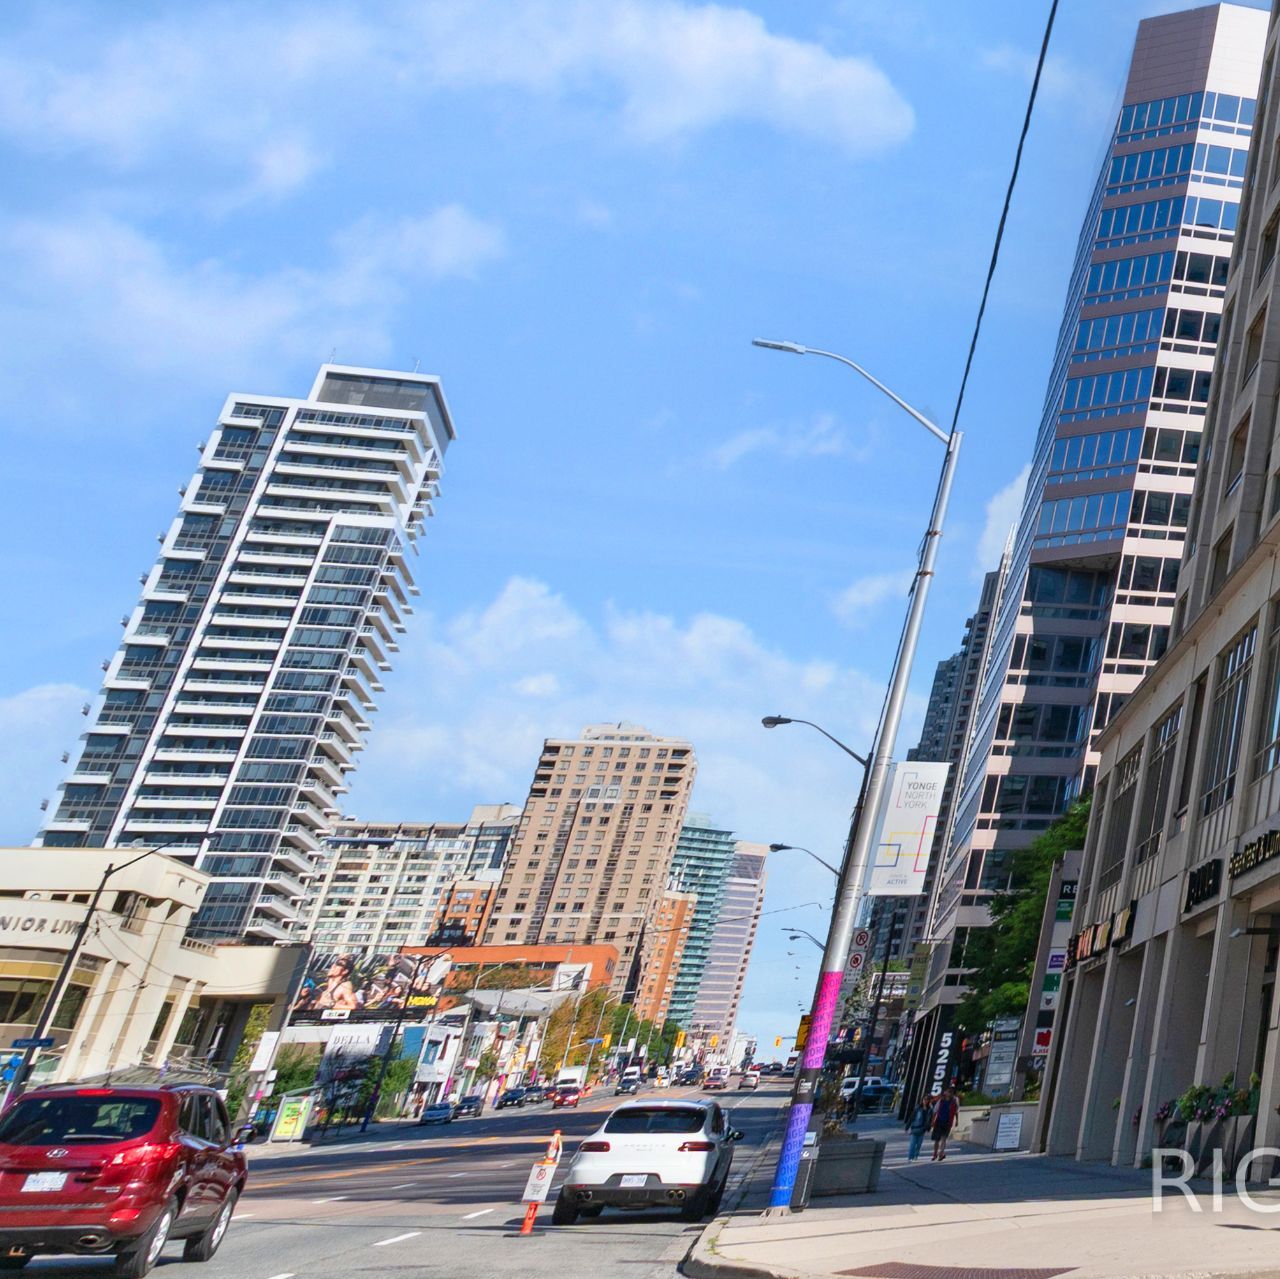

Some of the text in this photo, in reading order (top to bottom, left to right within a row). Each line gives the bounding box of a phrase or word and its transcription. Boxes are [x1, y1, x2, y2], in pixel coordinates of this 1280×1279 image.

[907, 782, 938, 791] YONGE
[904, 791, 936, 800] NORTH
[903, 801, 928, 809] YORK
